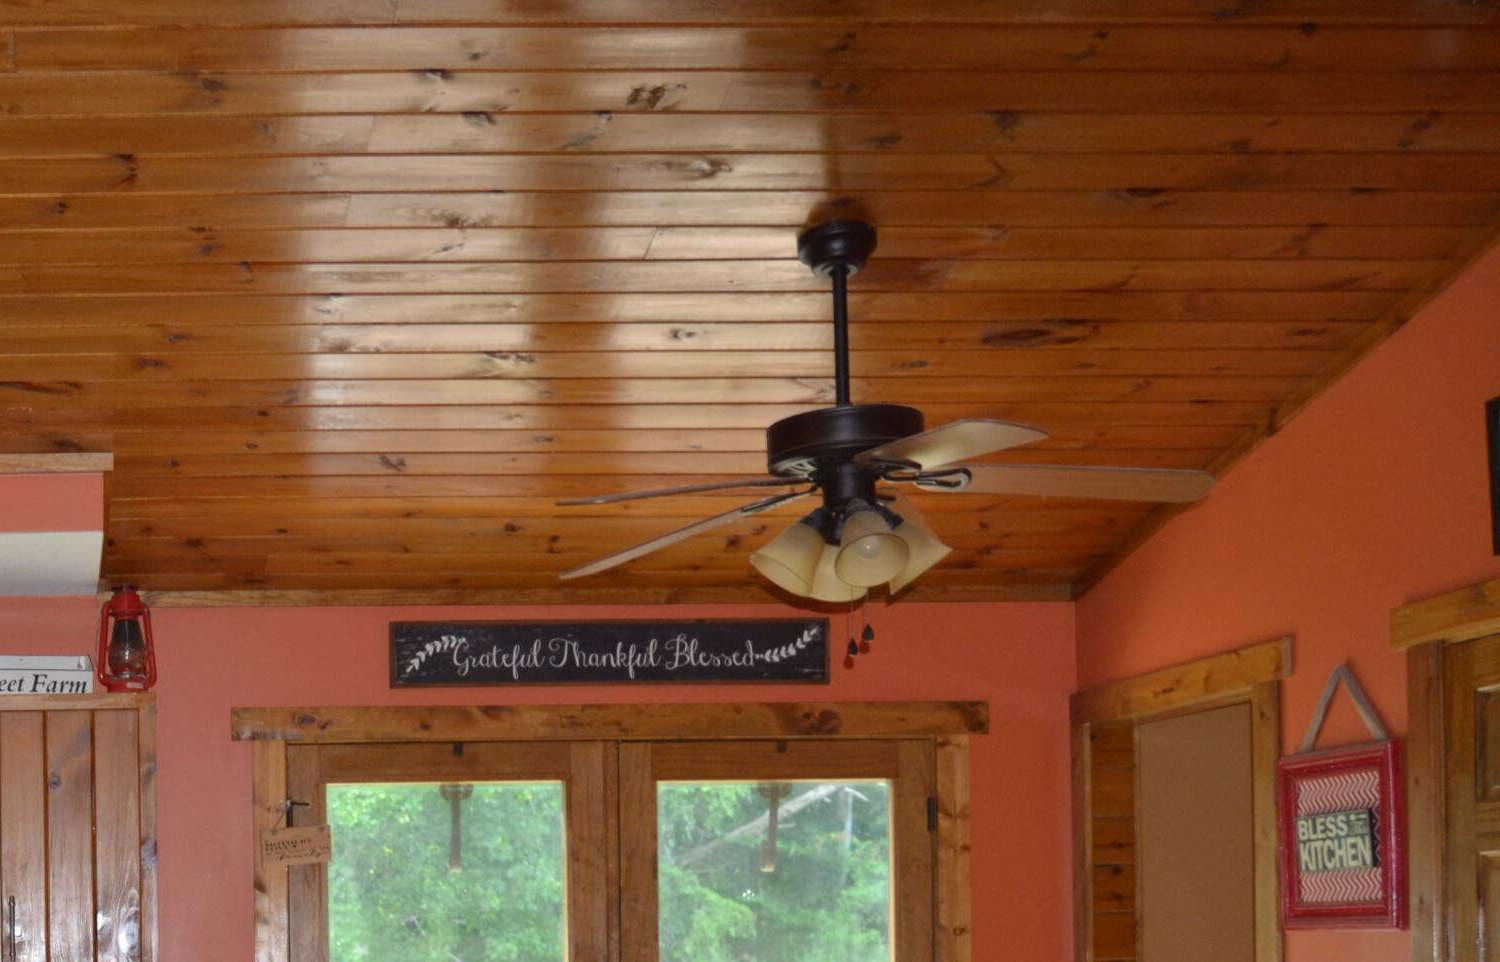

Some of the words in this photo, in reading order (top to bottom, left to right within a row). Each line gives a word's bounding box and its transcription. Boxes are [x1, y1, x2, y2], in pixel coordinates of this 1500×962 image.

[452, 637, 546, 679] Grateful
[548, 637, 661, 679] Thankful
[664, 633, 756, 671] Blessed
[30, 673, 88, 694] Farm
[1298, 814, 1348, 840] BLESS
[1300, 836, 1371, 871] KITCHEN
